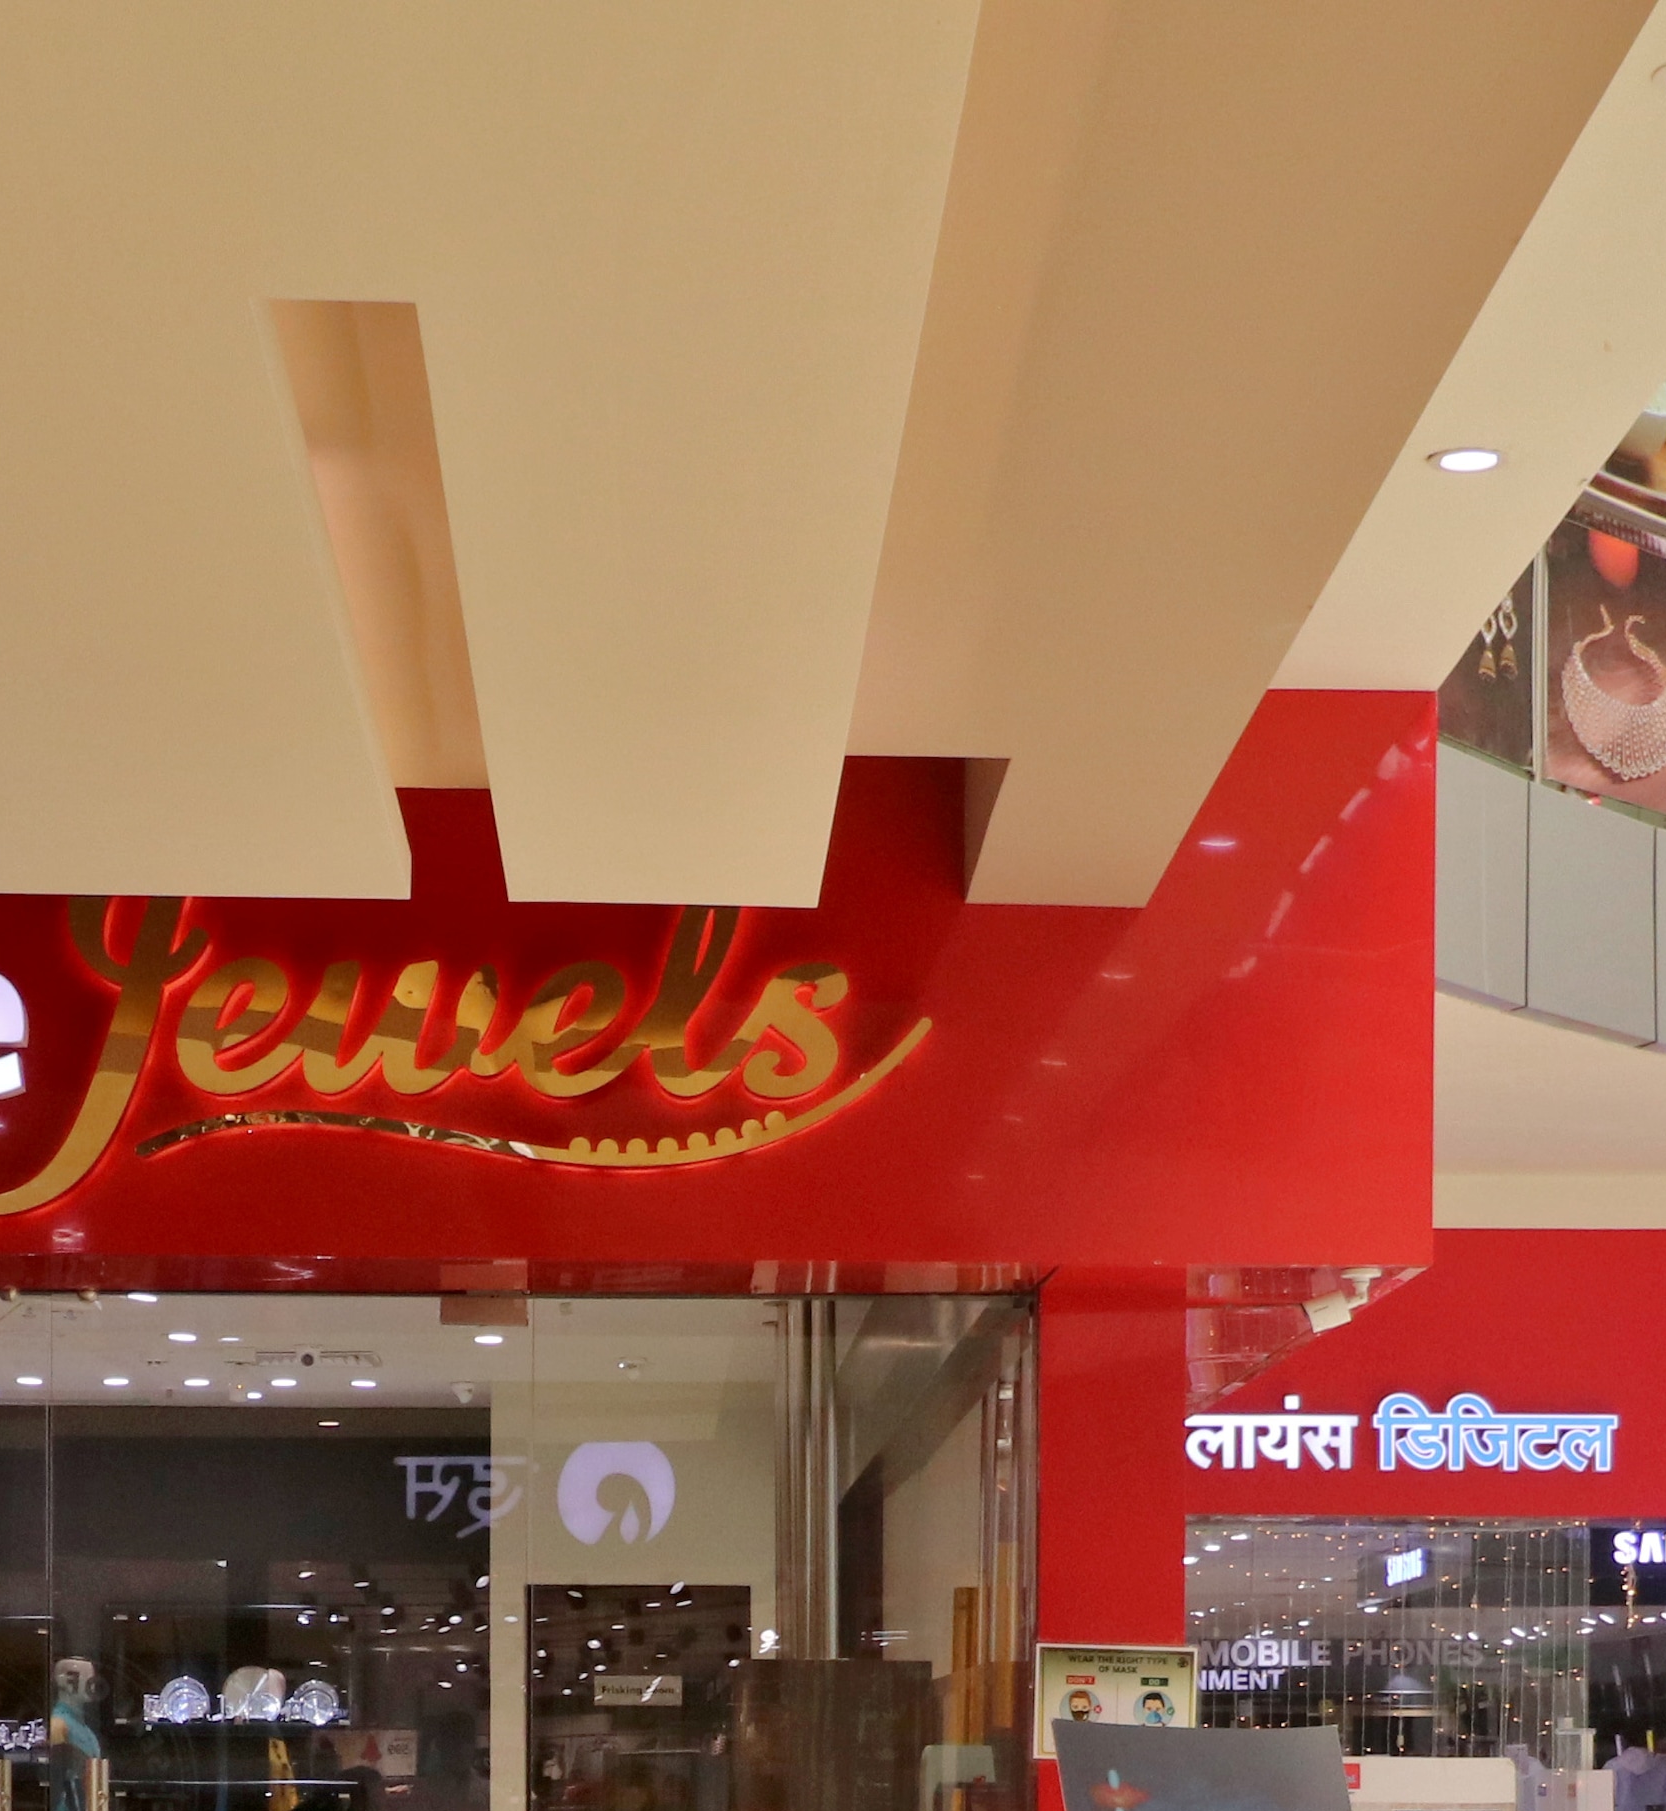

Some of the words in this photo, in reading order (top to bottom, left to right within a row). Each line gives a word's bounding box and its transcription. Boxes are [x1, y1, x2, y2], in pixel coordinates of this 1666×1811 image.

[1373, 1392, 1620, 1473] डिजिटल
[1202, 1639, 1331, 1668] MOBILE
[1343, 1639, 1484, 1668] PHONES
